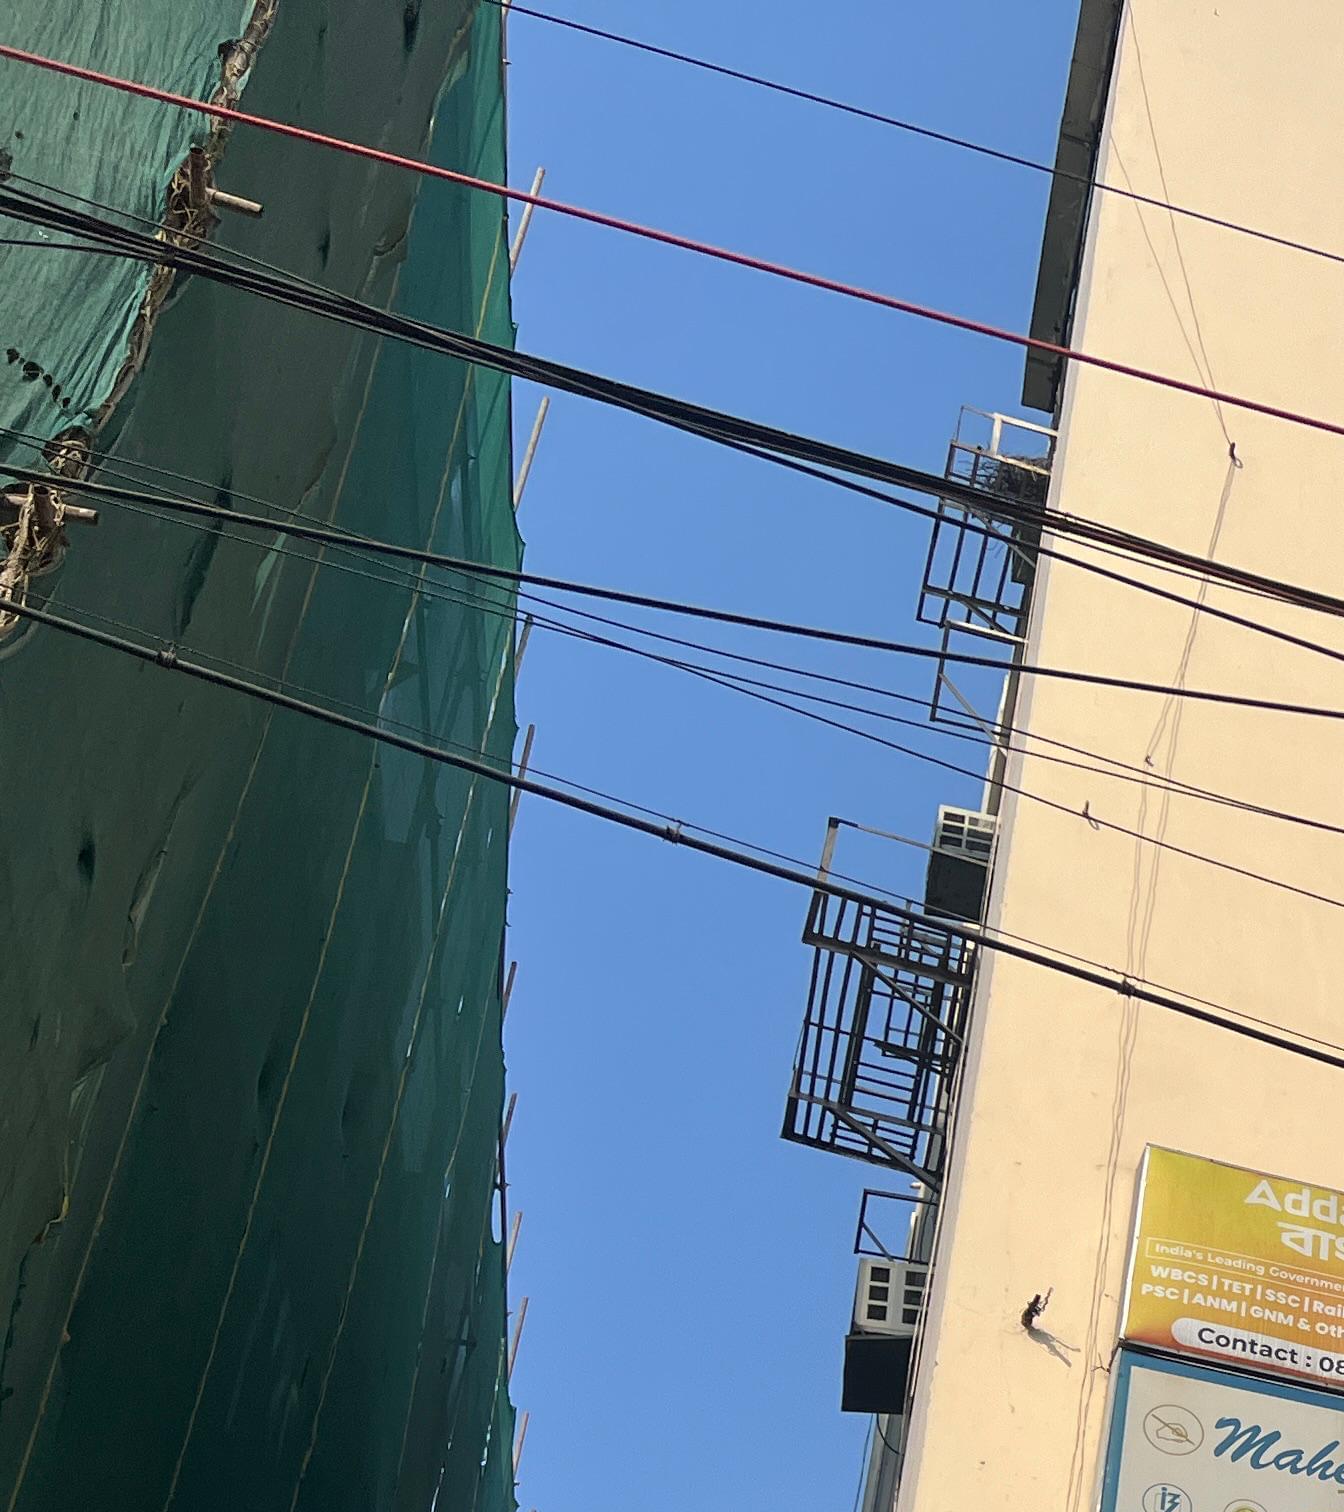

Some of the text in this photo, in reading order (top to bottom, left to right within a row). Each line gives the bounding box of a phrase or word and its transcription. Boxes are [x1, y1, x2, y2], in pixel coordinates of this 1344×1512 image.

[1156, 1243, 1204, 1260] India's
[1208, 1253, 1265, 1275] Leading
[1150, 1265, 1209, 1286] WBCS
[1221, 1278, 1253, 1296] TET
[1265, 1288, 1301, 1308] SSC
[1141, 1283, 1180, 1300] PSC
[1191, 1293, 1238, 1313] ANM
[1250, 1305, 1294, 1327] GNM
[1297, 1317, 1311, 1333] &
[1197, 1327, 1299, 1365] Contact
